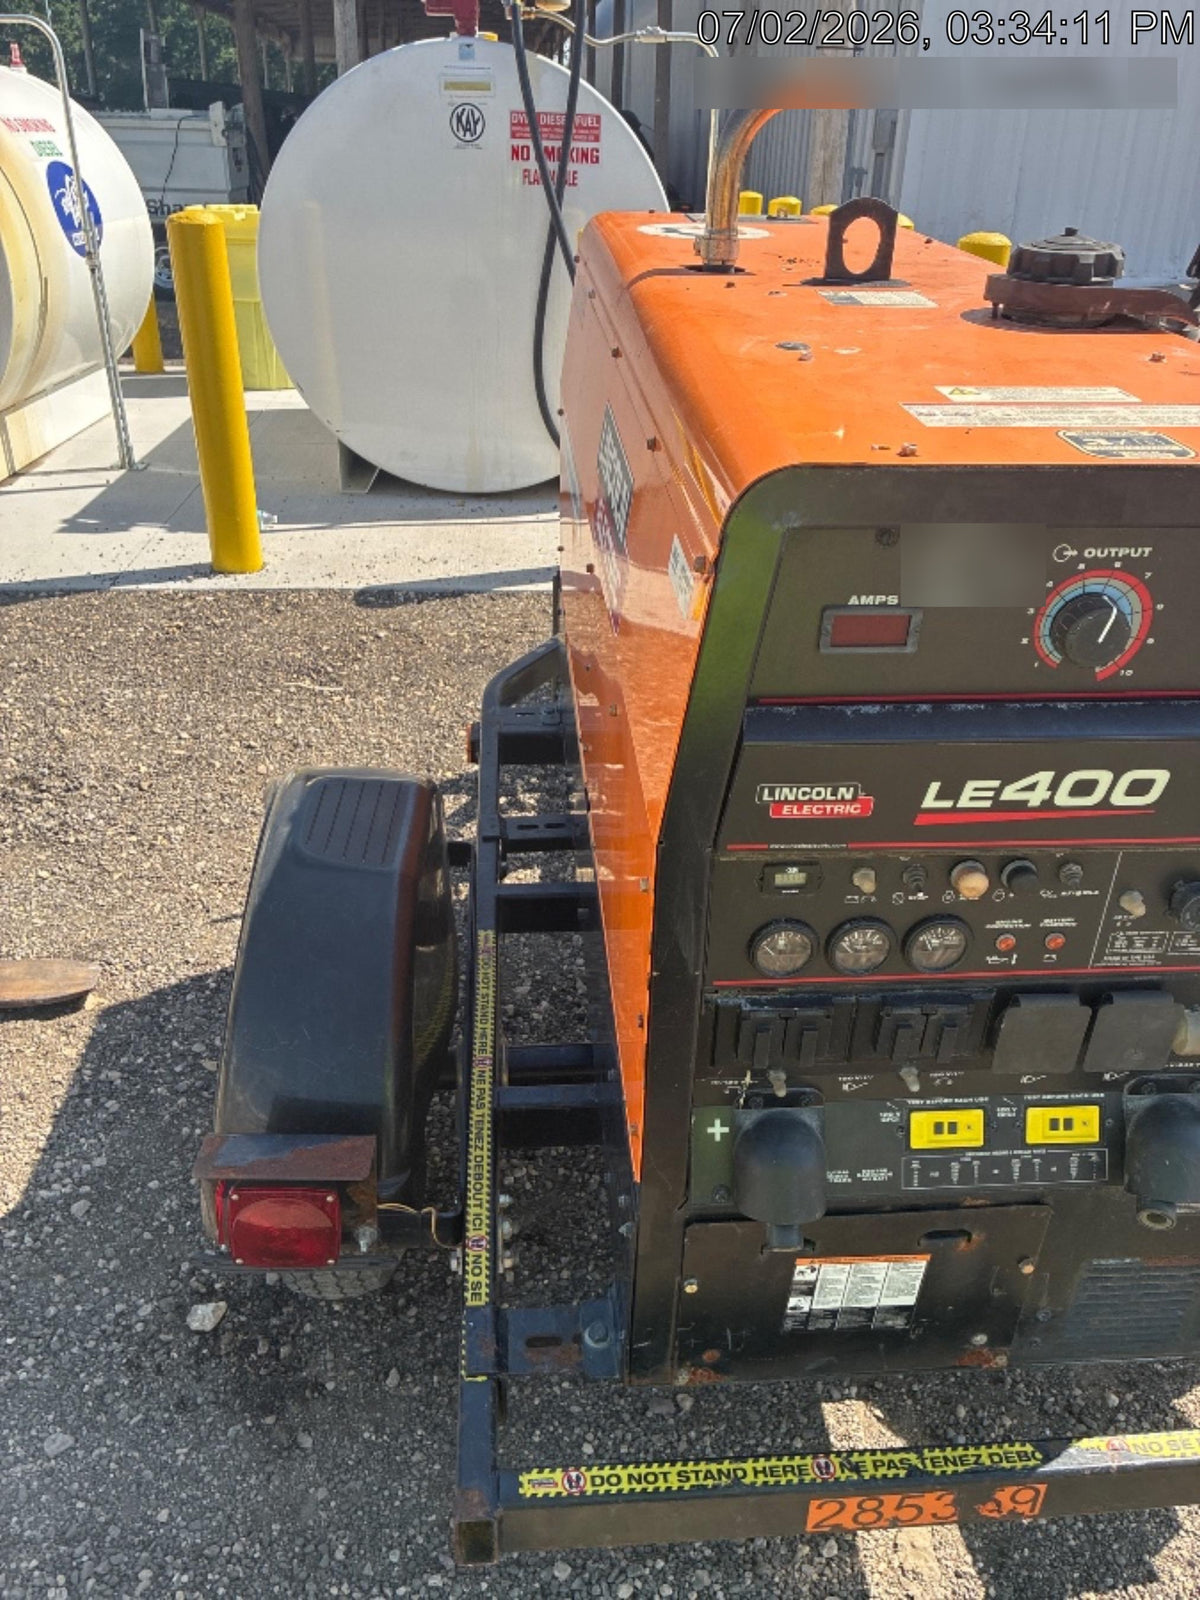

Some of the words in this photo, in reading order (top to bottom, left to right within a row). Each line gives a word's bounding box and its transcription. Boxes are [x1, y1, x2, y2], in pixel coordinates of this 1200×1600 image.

[456, 108, 480, 138] KAY
[540, 114, 568, 126] DIESE
[574, 116, 599, 127] FUEL
[511, 145, 530, 161] NO
[534, 146, 600, 164] MOKING
[1083, 547, 1153, 558] OUTPUT
[847, 595, 899, 606] AMPS
[762, 787, 854, 801] LINCOLN
[920, 769, 1171, 809] LE400
[782, 804, 862, 815] ELECTRIC
[481, 972, 491, 990] NOT
[480, 993, 490, 1025] STAND
[478, 1026, 489, 1055] HERE
[476, 1070, 486, 1086] NE
[475, 1088, 485, 1110] PAS
[474, 1112, 485, 1152] TENEZ
[473, 1155, 484, 1209] DEBOUT
[472, 1213, 482, 1232] ICI
[471, 1254, 482, 1278] NO
[470, 1281, 482, 1303] SE
[1131, 1441, 1164, 1454] NO
[838, 1457, 868, 1474] NE
[872, 1456, 914, 1472] PAS
[920, 1453, 983, 1470] TENEZ
[590, 1473, 622, 1489] DO
[627, 1471, 671, 1486] NOT
[677, 1465, 747, 1484] STAND
[753, 1463, 812, 1479] HERE
